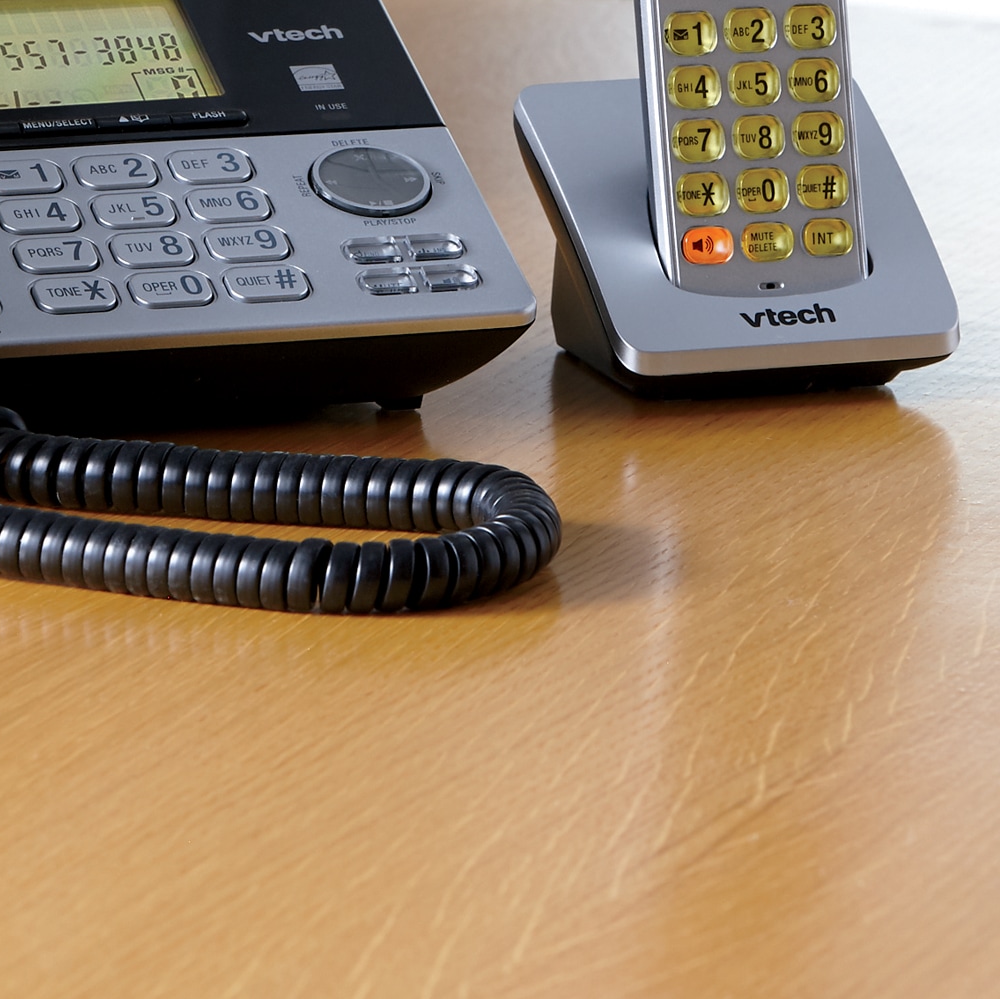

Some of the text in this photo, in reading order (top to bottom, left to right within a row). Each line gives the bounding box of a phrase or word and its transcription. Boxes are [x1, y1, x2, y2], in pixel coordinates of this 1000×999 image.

[248, 25, 344, 43] vtech
[692, 22, 702, 45] 1
[733, 19, 765, 43] ABC 2
[792, 16, 825, 40] DEF 3
[143, 67, 175, 75] MSG
[794, 69, 828, 93] MNO 6
[678, 75, 708, 99] GHI 4
[736, 72, 768, 96] JKL 5
[192, 111, 226, 120] FLASH
[328, 102, 348, 110] USE
[22, 118, 93, 130] MENU/SELECT
[797, 122, 832, 146] WXYZ 9
[331, 138, 370, 147] DELETE
[678, 128, 712, 152] PQRS 7
[740, 125, 772, 149] TUV 8
[89, 158, 148, 178] ABC 2
[181, 152, 241, 172] DEF 3
[29, 163, 48, 182] 1
[682, 189, 701, 200] TONE
[742, 178, 775, 202] OPER 0
[802, 175, 837, 200] QUIET #
[108, 196, 164, 216] JKL 5
[199, 190, 259, 211] MNO 6
[14, 202, 67, 221] GHI 4
[363, 217, 417, 227] PLAY/STOP
[125, 235, 183, 255] TUV 8
[218, 229, 277, 249] WXYZ 9
[750, 232, 774, 242] MUTE
[812, 232, 834, 245] INT
[28, 241, 83, 260] PQRS 7
[748, 242, 778, 253] DELETE
[142, 275, 202, 295] OPER 0
[236, 269, 297, 289] QUIET #
[46, 287, 83, 297] TONE
[739, 303, 837, 327] vtech
